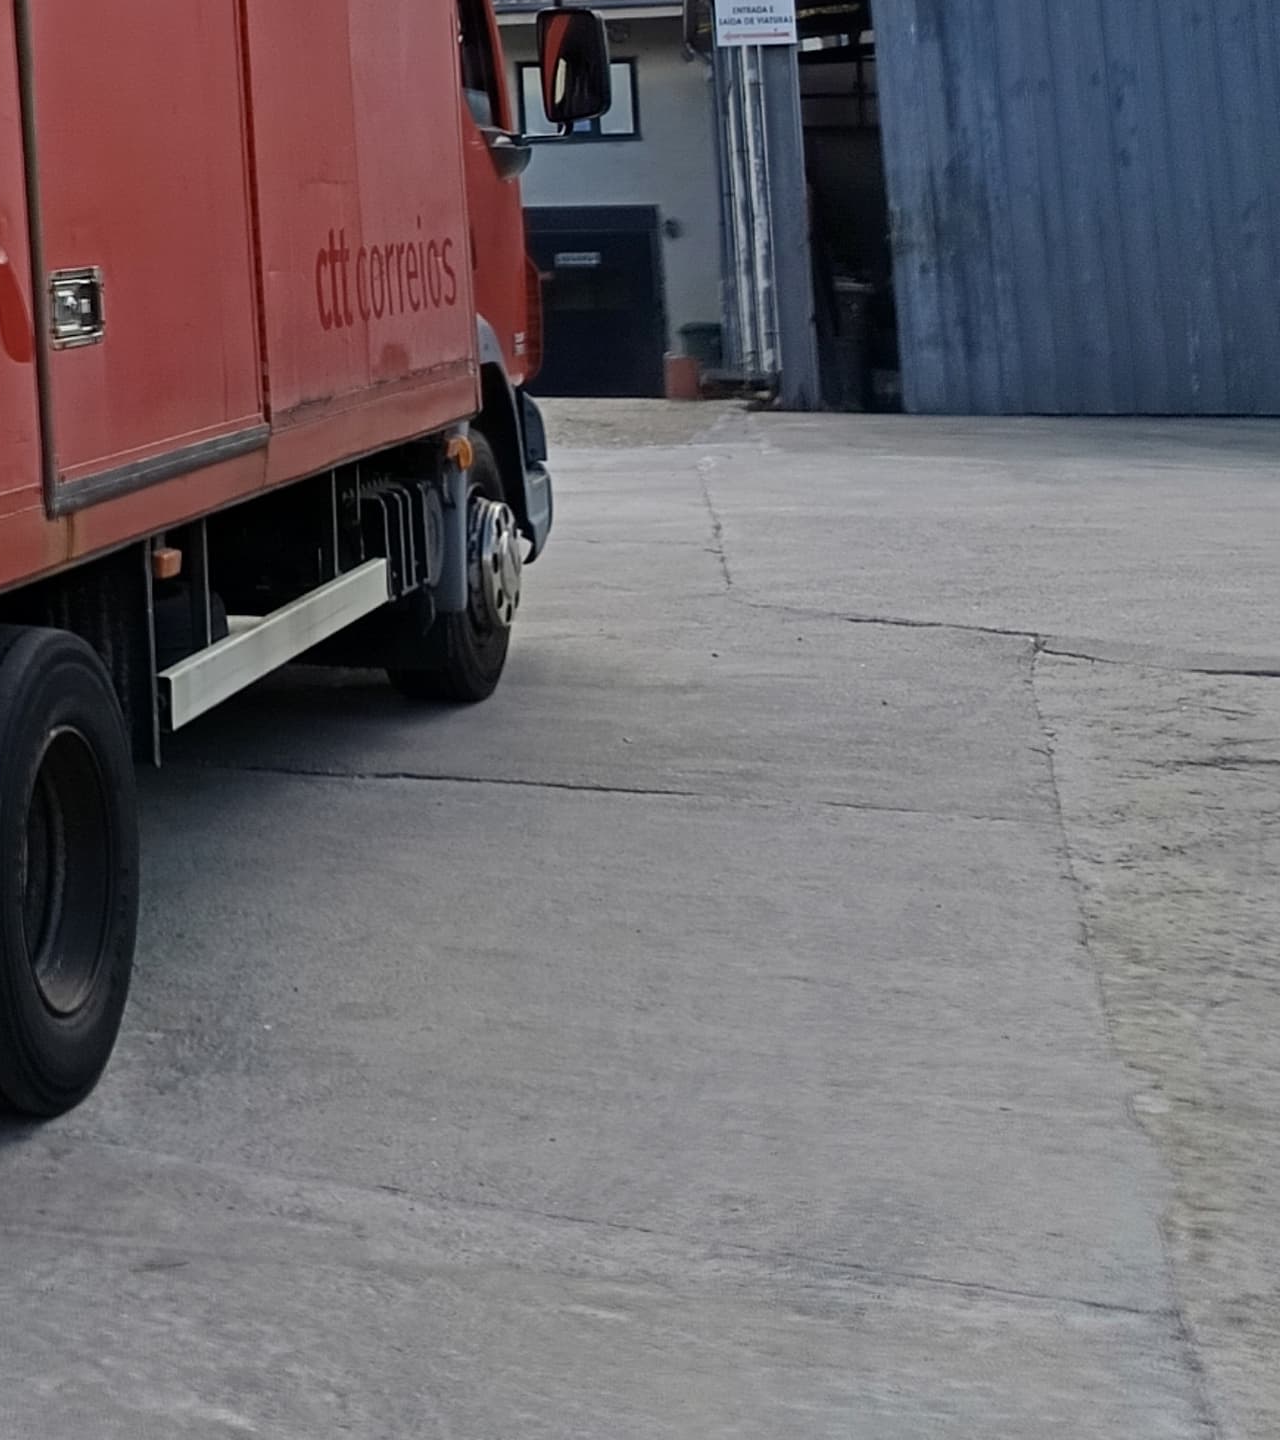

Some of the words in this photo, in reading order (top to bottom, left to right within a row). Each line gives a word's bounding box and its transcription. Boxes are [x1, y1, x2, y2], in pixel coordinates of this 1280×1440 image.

[732, 6, 767, 15] ENTRADA
[315, 228, 354, 331] ctt
[356, 215, 456, 321] correios
